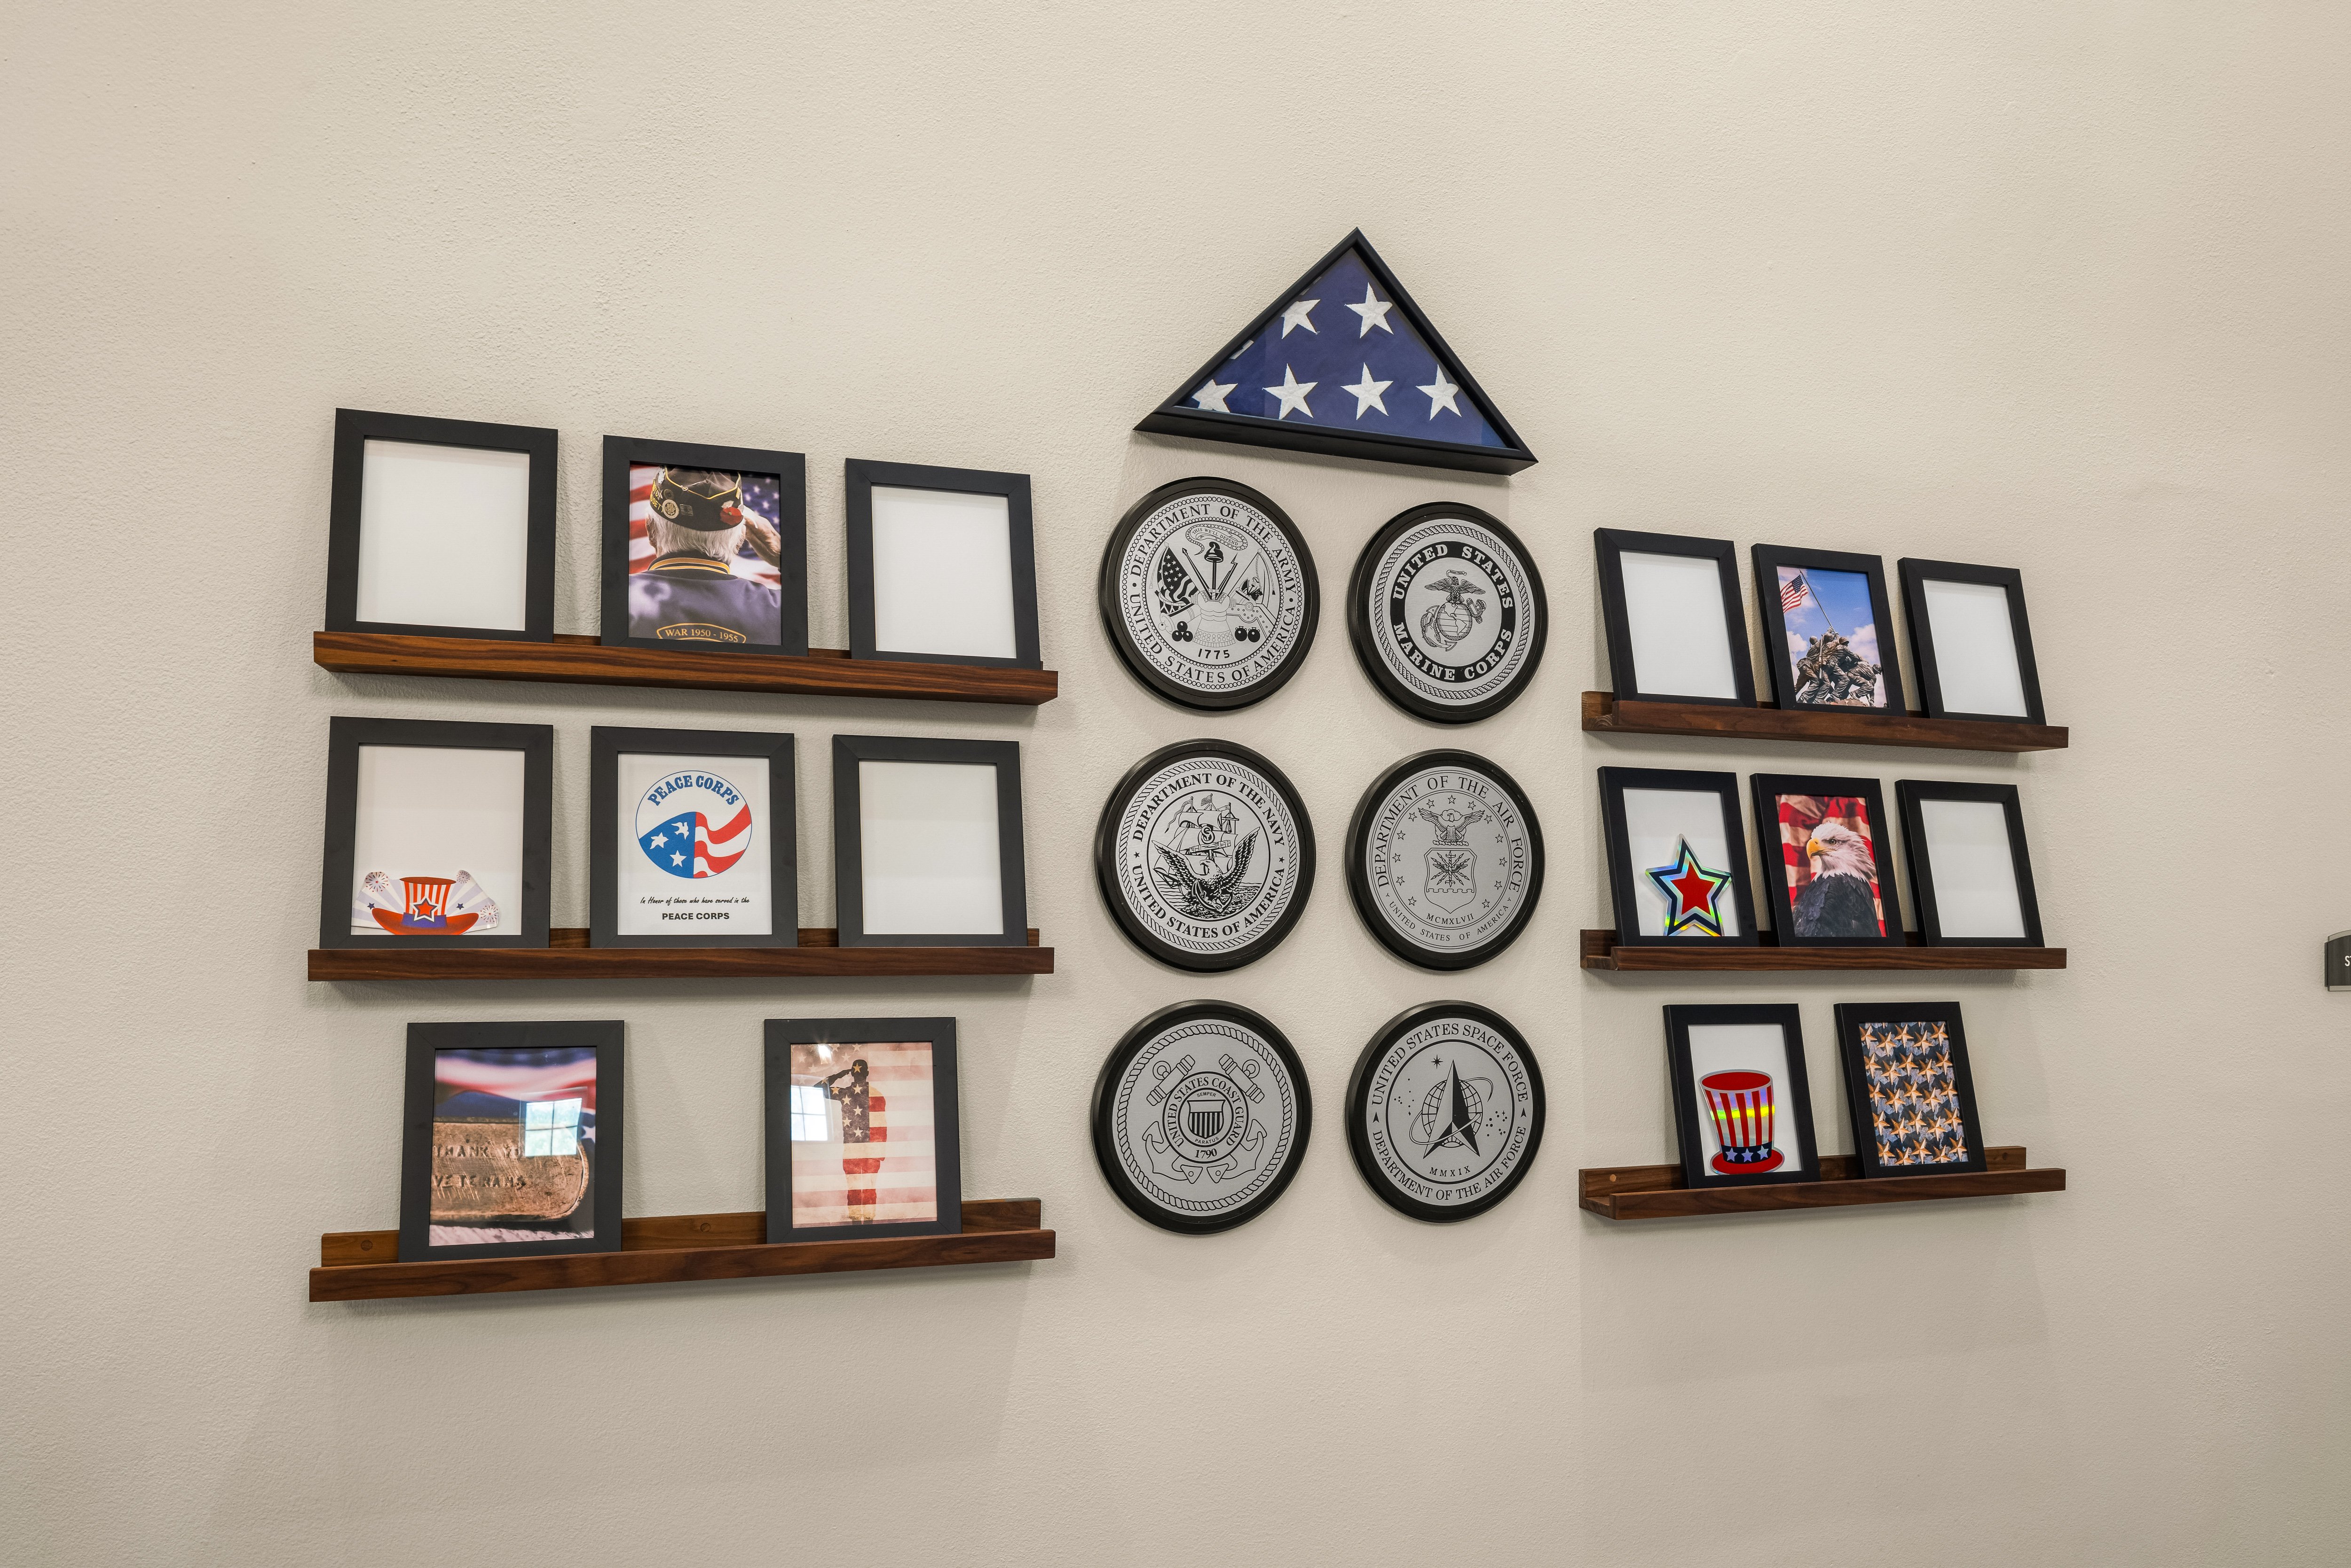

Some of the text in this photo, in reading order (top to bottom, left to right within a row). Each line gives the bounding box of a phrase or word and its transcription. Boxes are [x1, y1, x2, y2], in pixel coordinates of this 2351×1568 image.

[1130, 504, 1295, 595] DEPARTMENT OF THE ARMY
[1220, 535, 1239, 546] DEFEND
[1393, 545, 1513, 609] UNITED STATES
[720, 632, 738, 642] 1955
[1130, 594, 1295, 683] UNITED STATES OF AMERICA
[1198, 648, 1231, 659] 1775
[1394, 622, 1512, 681] MARINE CORPS
[647, 775, 740, 806] PEACE CORPS
[1133, 773, 1285, 846] DEPARTMENT OF THE NAVY
[1374, 776, 1524, 892] DEPARTMENT OF THE AIR FORCE
[665, 897, 672, 906] of
[1132, 864, 1285, 938] UNITED STATES OF AMERICA
[1389, 901, 1509, 941] UNITED STATES OF AMERICA
[1427, 913, 1474, 925] MCMXLVII
[2344, 955, 2351, 967] S
[1372, 1023, 1528, 1105] UNITED STATES SPACE FORCE
[1167, 1076, 1244, 1148] UNITED STATES COAST GUARD
[1195, 1136, 1219, 1144] PARATUS
[1195, 1148, 1217, 1158] 1790
[1373, 1126, 1526, 1200] DEPARTMENT OF THE AIR FORCE
[1429, 1165, 1471, 1177] MMXIX
